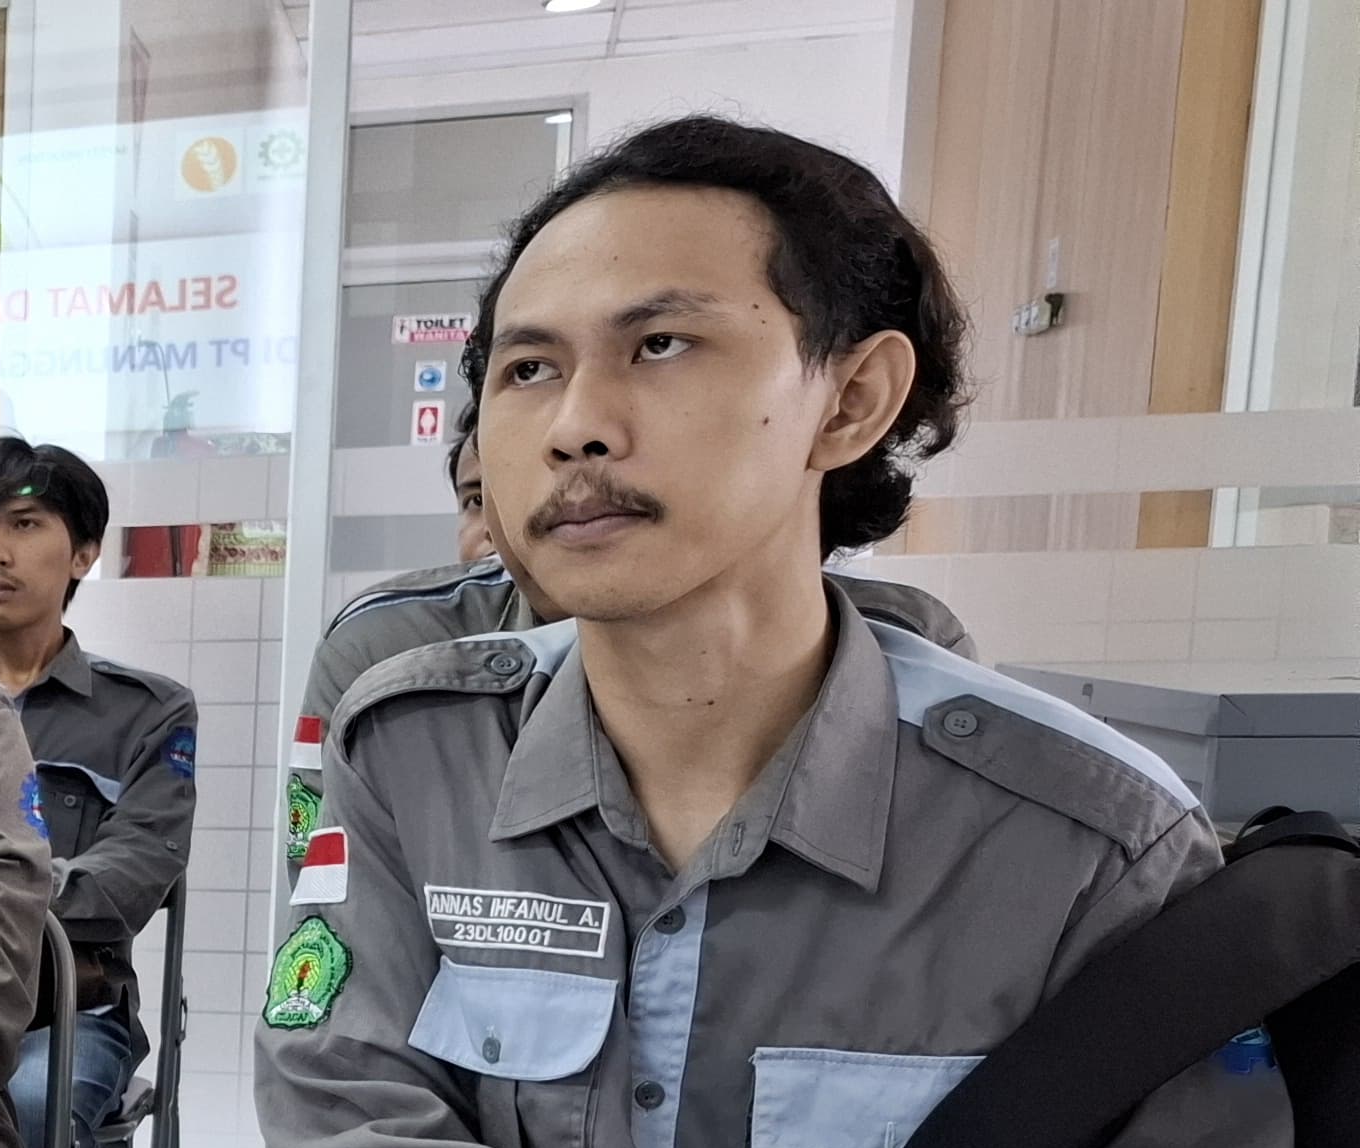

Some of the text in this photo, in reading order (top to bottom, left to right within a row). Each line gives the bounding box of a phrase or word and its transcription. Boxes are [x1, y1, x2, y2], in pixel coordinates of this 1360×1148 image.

[415, 318, 466, 330] TOILET
[430, 893, 600, 928] ANNAS IHFANUL A.
[453, 923, 552, 946] 23DL10001
